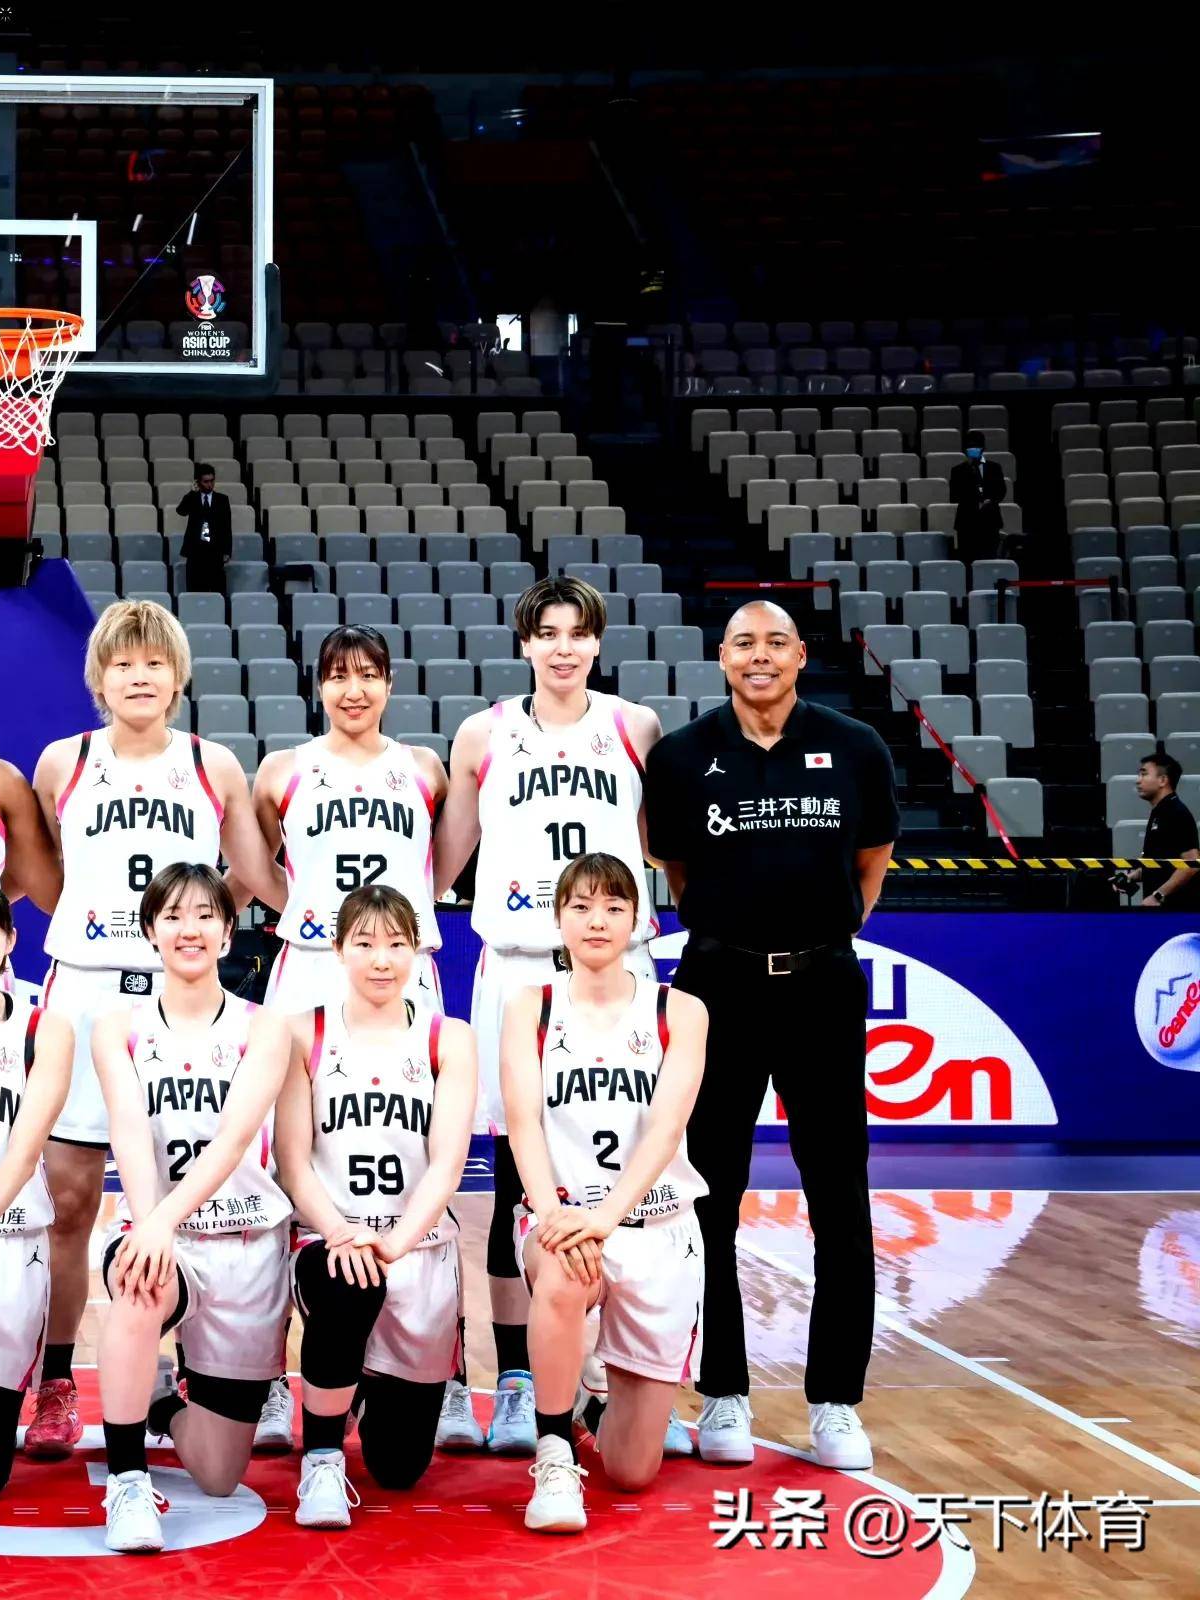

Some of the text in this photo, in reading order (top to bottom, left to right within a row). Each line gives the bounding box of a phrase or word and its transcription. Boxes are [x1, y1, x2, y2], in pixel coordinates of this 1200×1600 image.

[182, 336, 231, 349] ASIA CUP
[182, 349, 231, 358] CHINA 2025
[509, 764, 618, 807] JAPAN
[85, 797, 194, 840] JAPAN
[306, 797, 414, 839] JAPAN
[738, 797, 841, 819] 三井不動産
[739, 818, 841, 831] MITSUI FUDOSAN
[544, 822, 586, 860] 10
[128, 854, 153, 892] 8
[336, 854, 387, 892] 52
[110, 930, 144, 939] MITSU
[547, 1068, 656, 1108] JAPAN
[321, 1092, 432, 1138] JAPAN
[592, 1130, 621, 1171] 2
[348, 1153, 405, 1196] 59
[212, 1214, 269, 1228] FUDOSAN
[629, 1203, 679, 1217] UDOSAN
